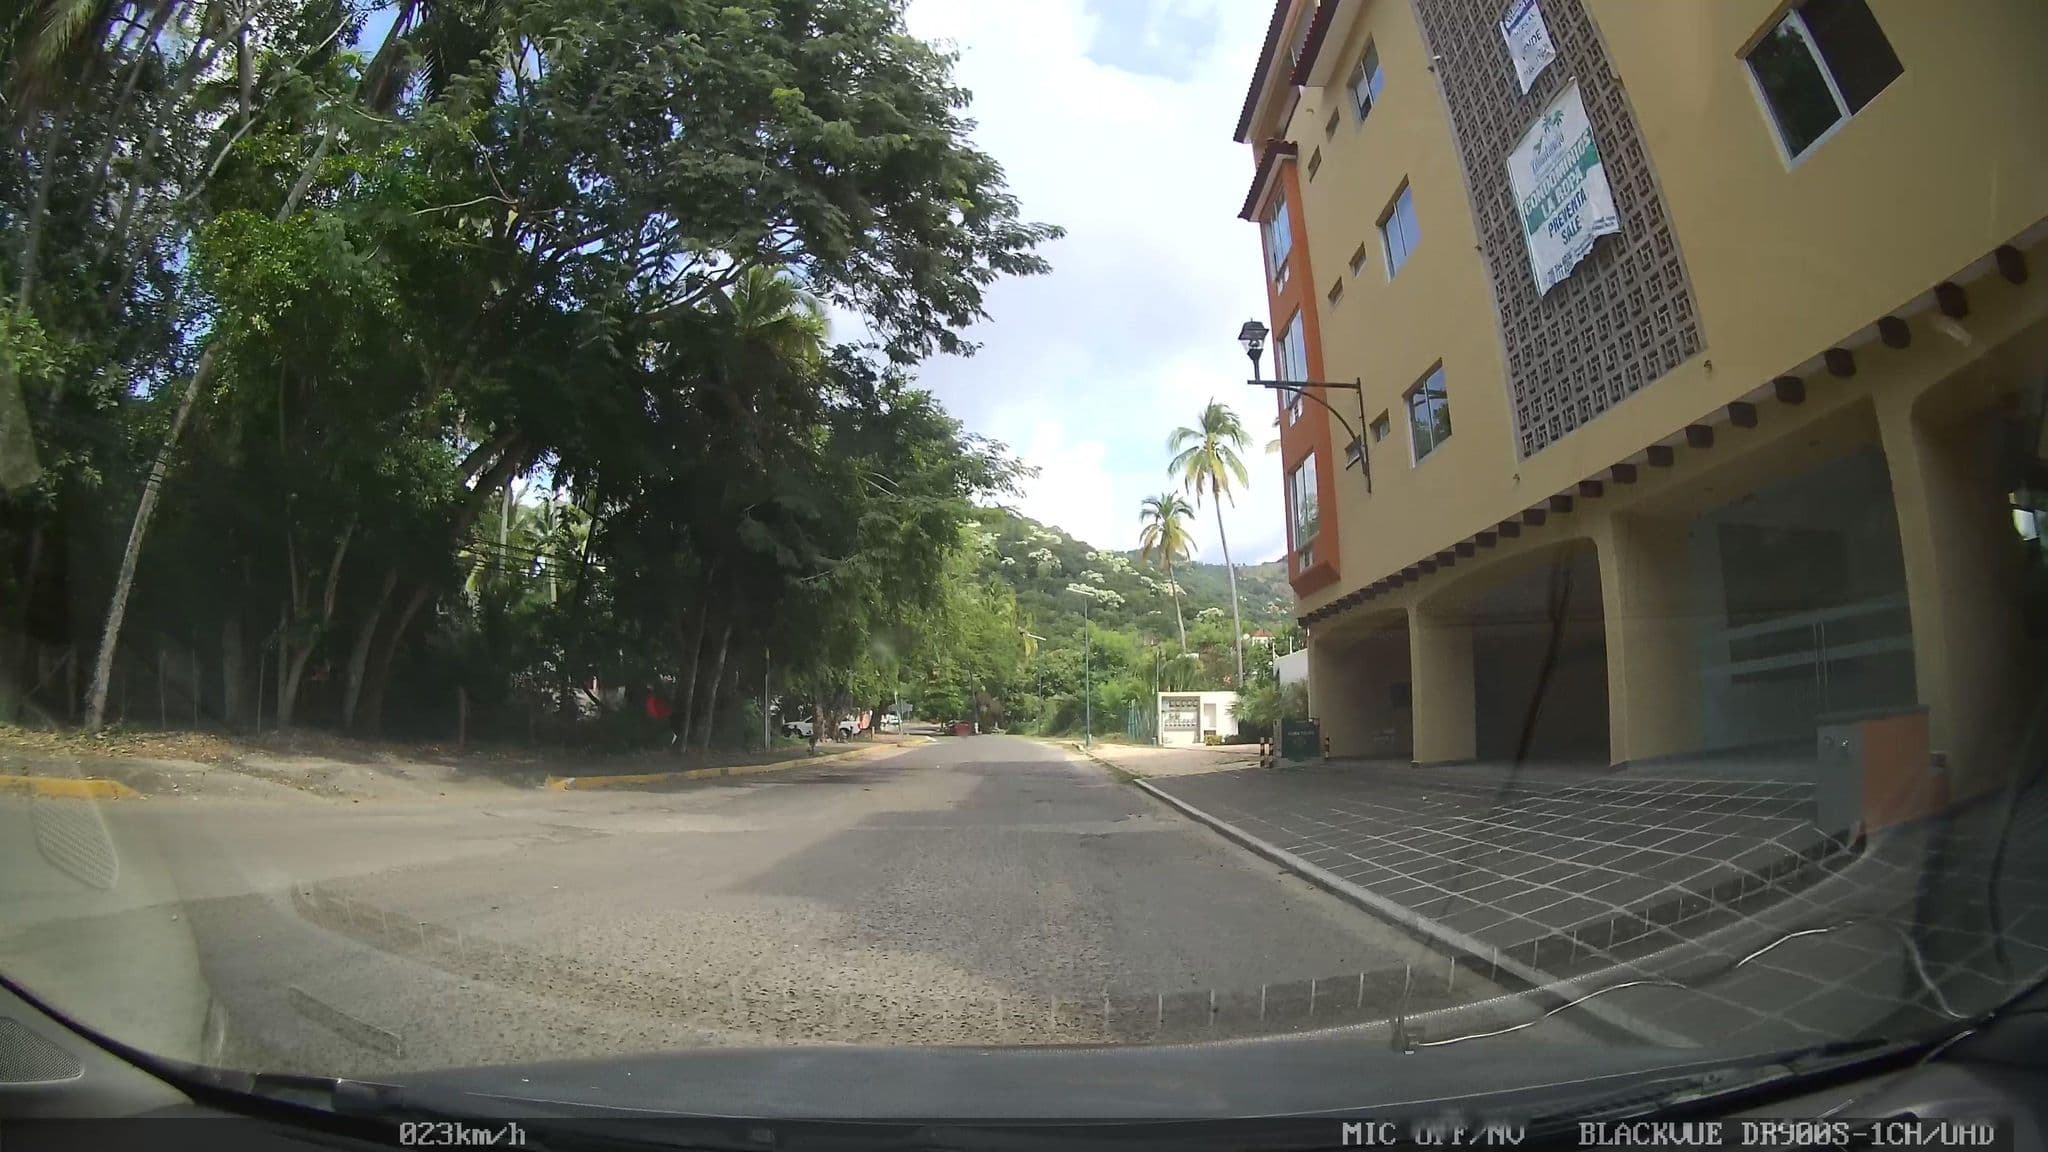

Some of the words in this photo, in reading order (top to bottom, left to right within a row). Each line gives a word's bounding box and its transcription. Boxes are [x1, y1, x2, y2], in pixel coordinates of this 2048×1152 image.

[1523, 133, 1591, 216] CONDOMINIOS
[1541, 200, 1553, 219] LA
[1554, 165, 1584, 201] ROPA
[1548, 187, 1588, 238] PREVENTA
[1560, 215, 1582, 245] SALE
